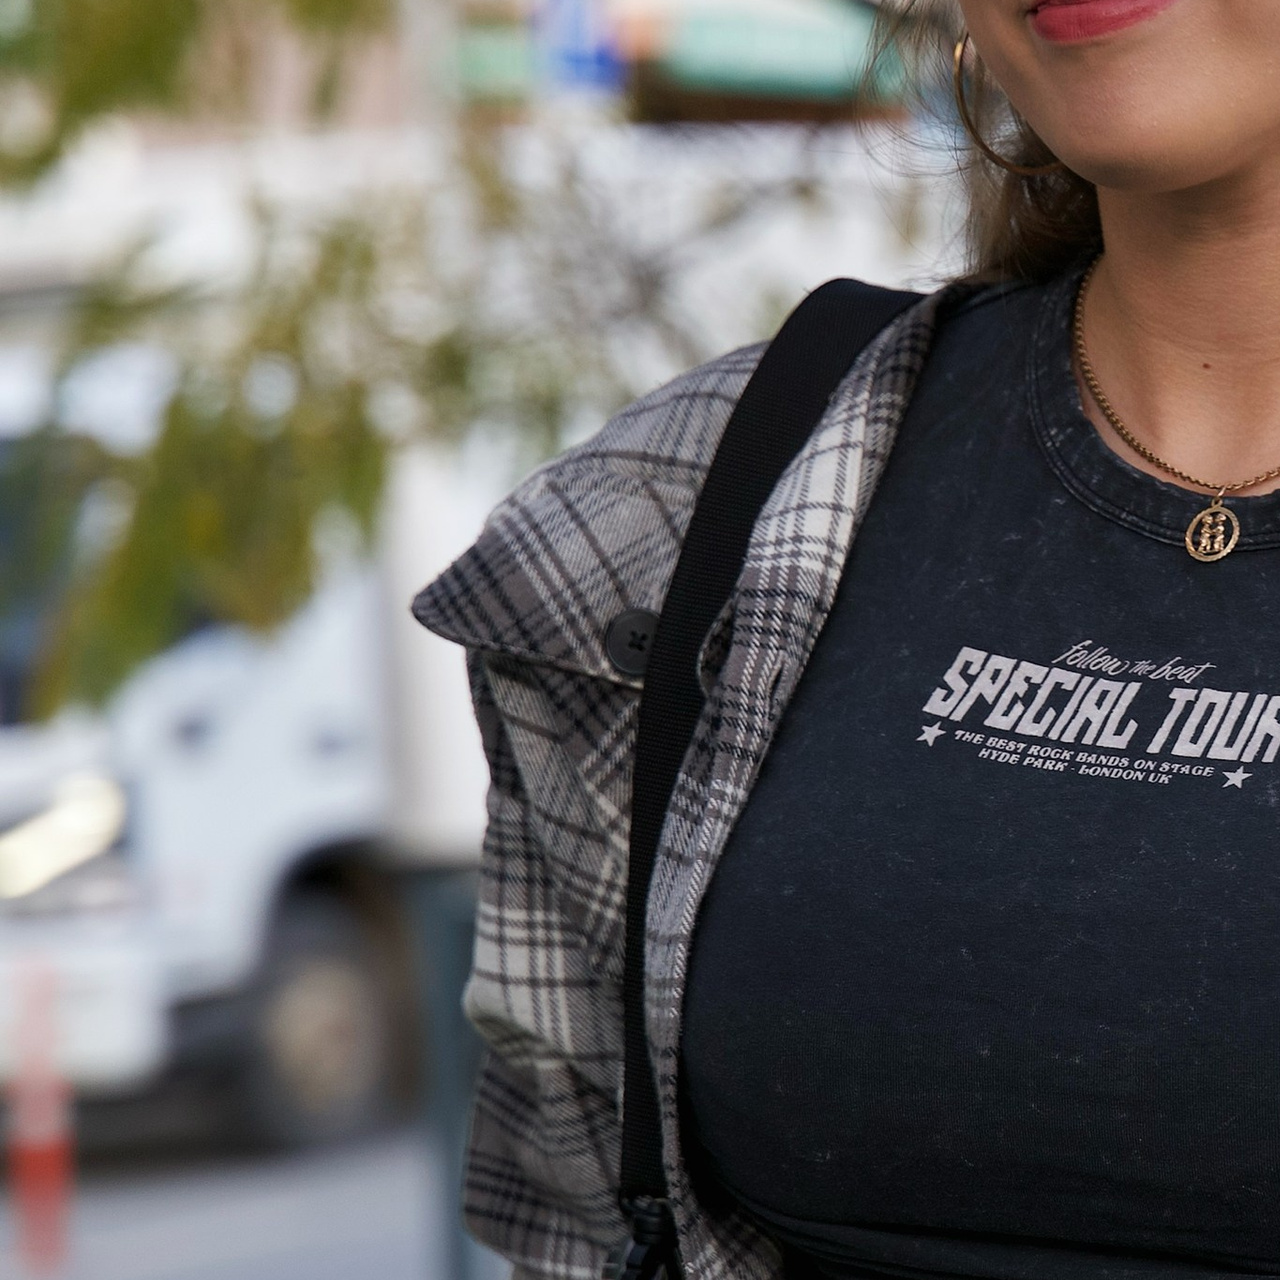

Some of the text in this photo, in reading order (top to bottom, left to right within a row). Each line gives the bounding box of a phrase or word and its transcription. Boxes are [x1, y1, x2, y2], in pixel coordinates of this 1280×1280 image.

[1051, 639, 1217, 683] follow the beat
[921, 646, 1143, 750] SPECIAL
[954, 729, 1216, 778] THE BEST ROCK BANDS ON STAGE
[978, 747, 1021, 766] HYDE
[1022, 756, 1069, 772] PARK
[1077, 764, 1147, 781] LONDON
[1147, 772, 1173, 784] UK
